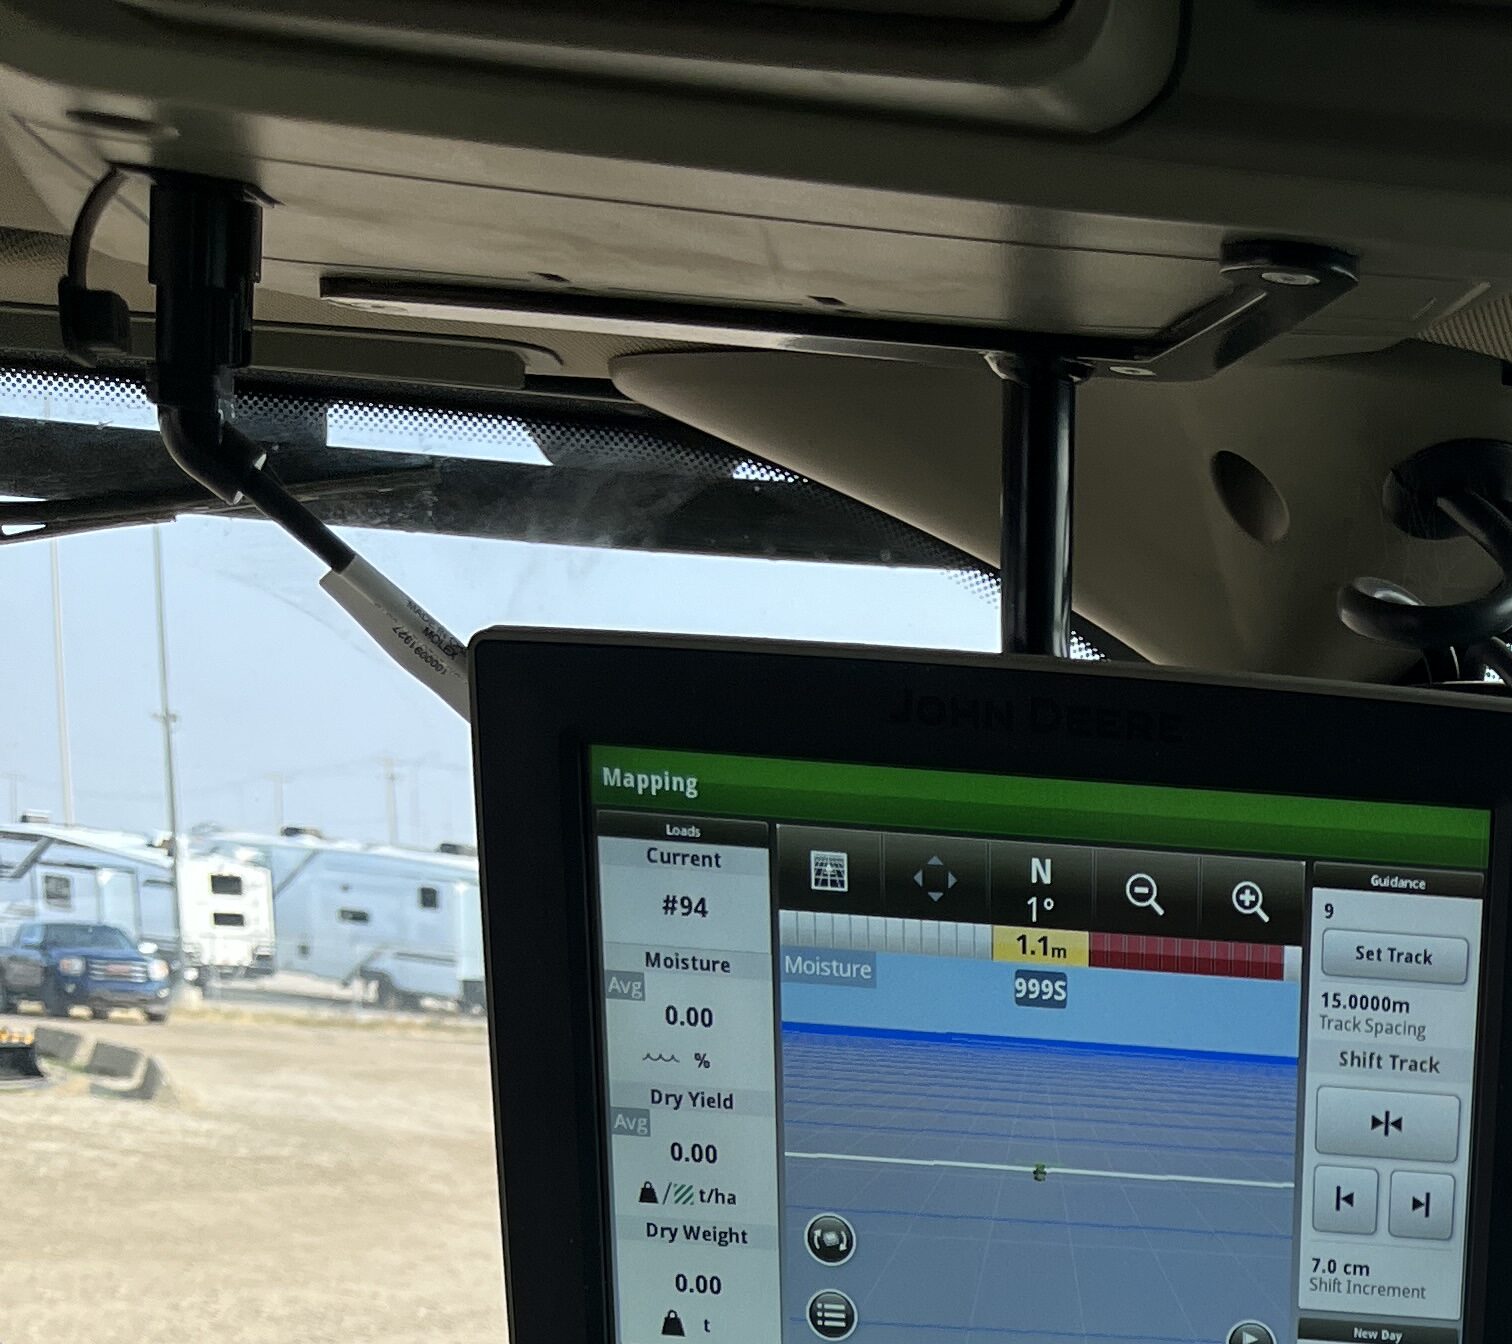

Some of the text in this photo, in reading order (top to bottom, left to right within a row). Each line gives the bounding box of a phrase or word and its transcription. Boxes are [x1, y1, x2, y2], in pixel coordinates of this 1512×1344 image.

[422, 626, 459, 660] MOLEX
[602, 766, 699, 799] Mapping
[665, 824, 701, 839] Loads
[646, 847, 722, 868] Current
[1031, 857, 1052, 885] N
[1370, 874, 1426, 890] Guidance
[662, 894, 709, 918] #94
[1324, 902, 1334, 919] 9
[645, 951, 731, 974] Moisture
[1355, 945, 1433, 966] Set Track
[784, 955, 872, 980] Moisture
[607, 976, 643, 999] Avg
[1321, 991, 1410, 1014] 15.0000m
[664, 1004, 714, 1028] 0.00
[1320, 1013, 1427, 1042] Track Spacing
[1339, 1050, 1440, 1074] Shift Track
[650, 1089, 734, 1111] Dry Yield
[614, 1113, 648, 1136] Avg
[670, 1142, 718, 1165] 0.00
[699, 1187, 737, 1206] t/ha
[645, 1222, 749, 1247] Dry Weight
[1311, 1257, 1370, 1277] 7.0 cm
[675, 1273, 722, 1296] 0.00
[1309, 1276, 1427, 1300] Shift Increment
[703, 1317, 711, 1334] t
[1353, 1327, 1403, 1344] New Day
